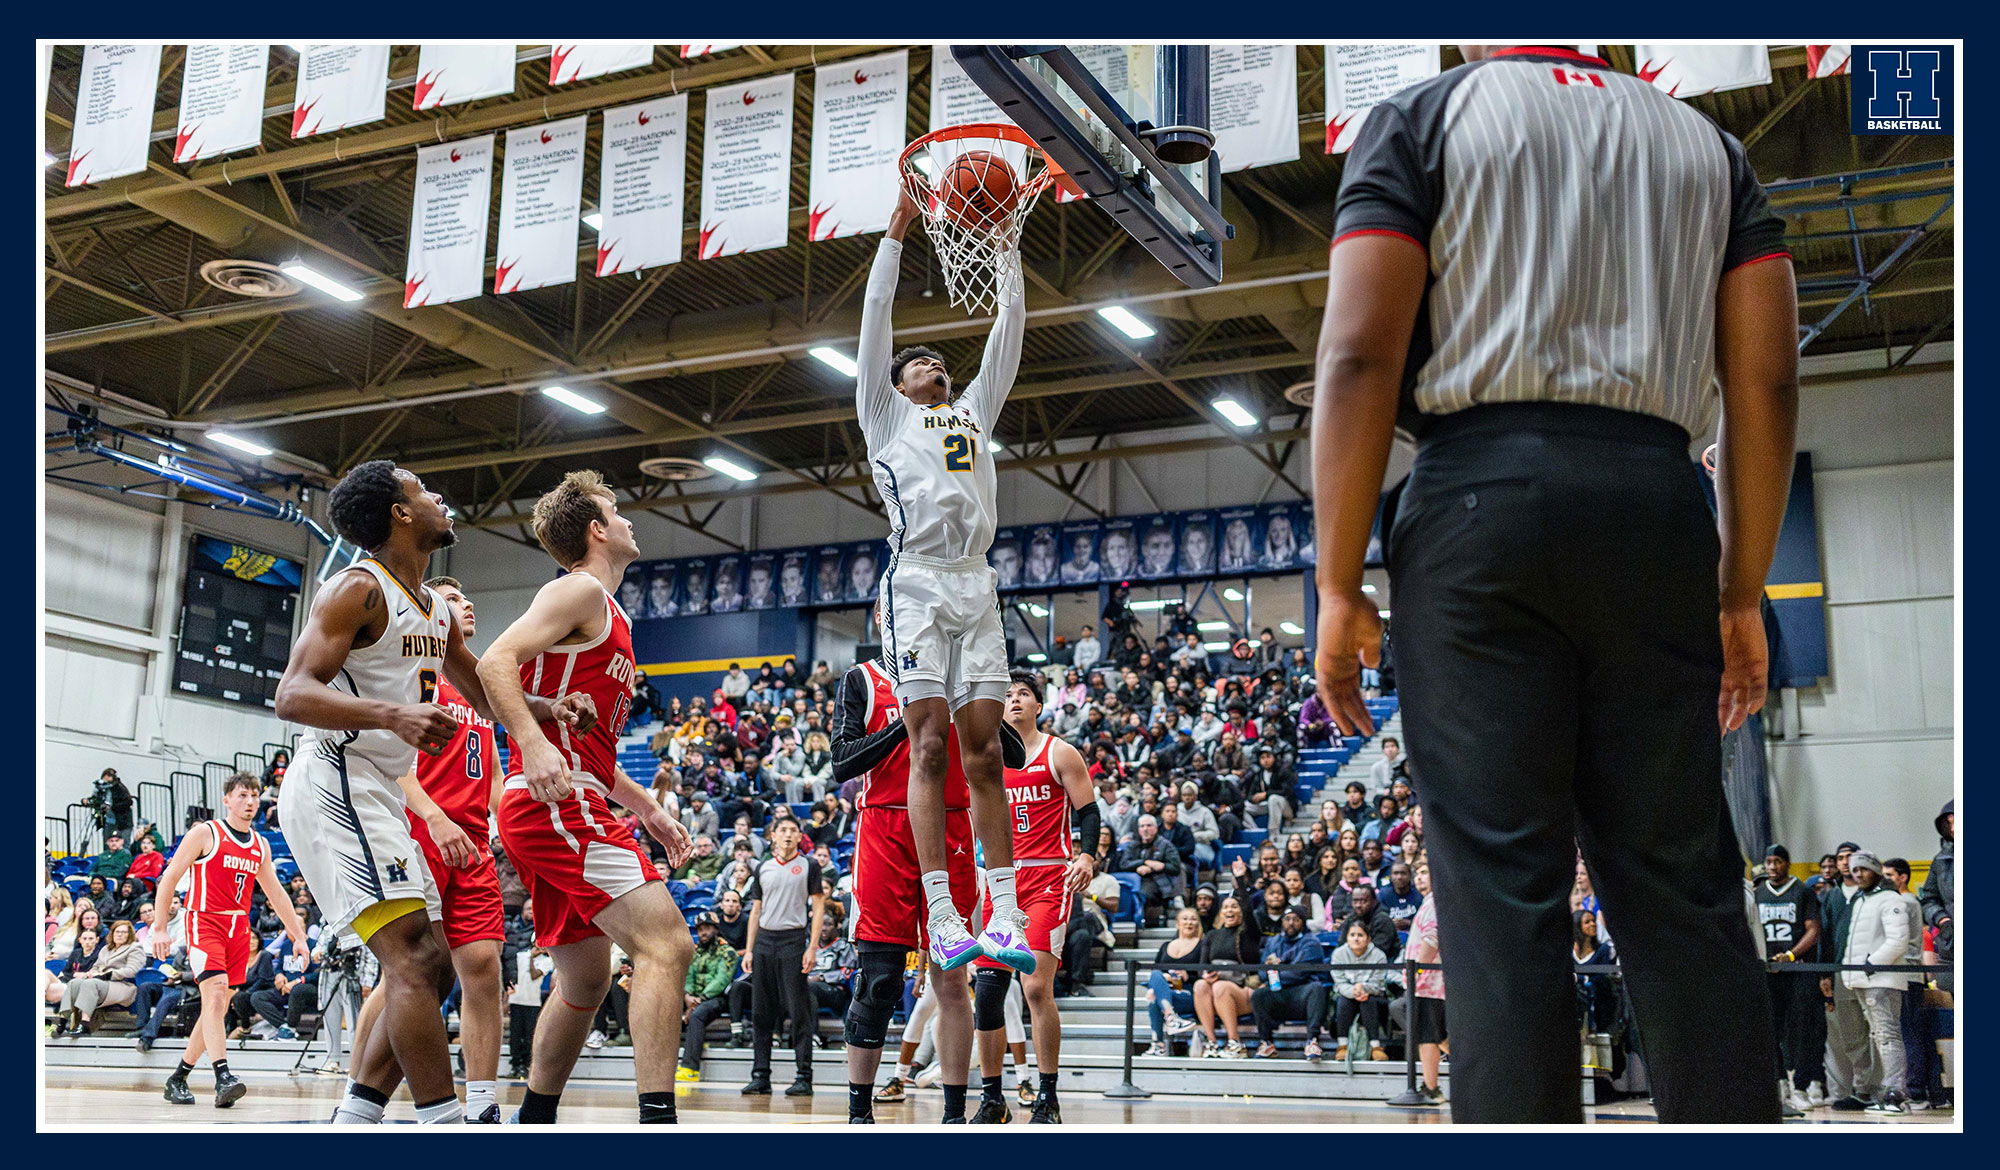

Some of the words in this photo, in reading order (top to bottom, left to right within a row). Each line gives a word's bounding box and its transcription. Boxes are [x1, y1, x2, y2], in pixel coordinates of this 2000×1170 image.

[857, 88, 897, 101] NATIONAL
[745, 108, 784, 121] NATIONAL
[640, 128, 677, 141] NATIONAL
[542, 147, 578, 160] NATIONAL
[743, 152, 782, 164] NATIONAL
[452, 167, 485, 179] NATIONAL
[466, 729, 483, 779] 8
[1005, 784, 1051, 804] OYALS
[1015, 805, 1030, 833] 5
[223, 854, 260, 875] ROYALS
[234, 872, 248, 904] 7
[1765, 923, 1793, 942] 12
